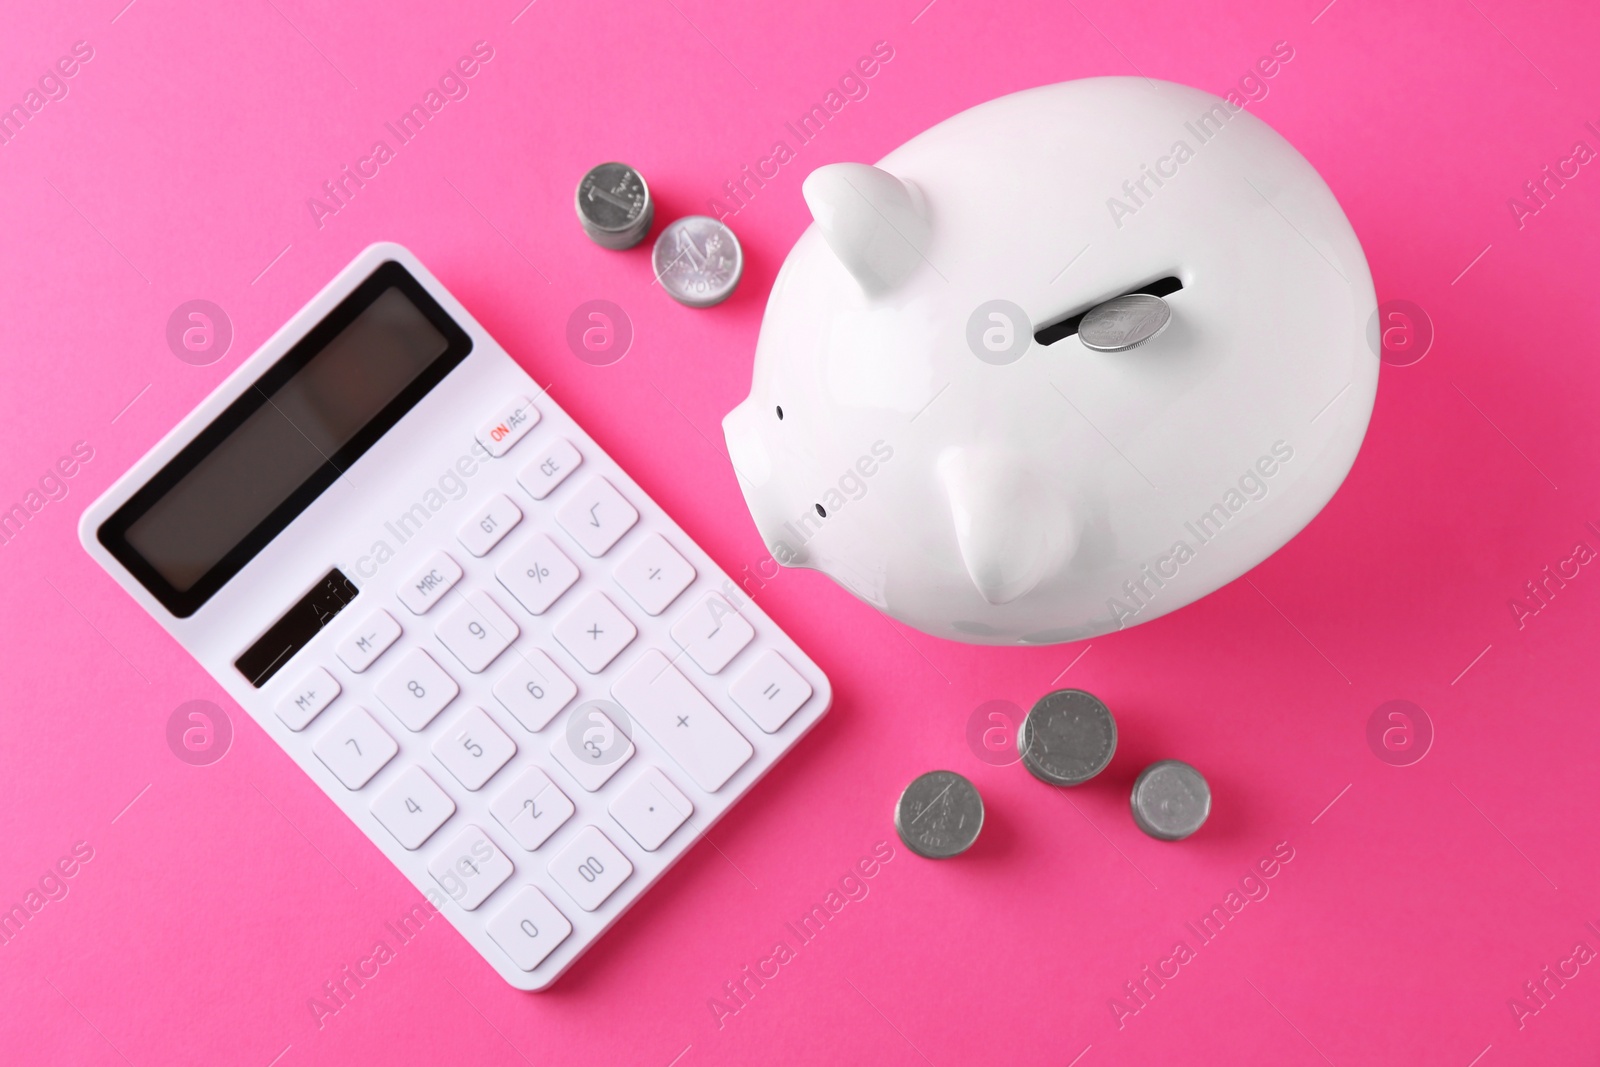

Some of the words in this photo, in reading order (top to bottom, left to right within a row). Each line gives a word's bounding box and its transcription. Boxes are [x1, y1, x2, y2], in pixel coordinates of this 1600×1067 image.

[588, 185, 632, 213] 1
[675, 224, 709, 274] 1
[490, 409, 527, 442] ON/AC
[540, 458, 559, 477] CE
[480, 514, 498, 534] GT
[416, 569, 443, 597] MRC
[468, 621, 486, 640] 9
[407, 680, 426, 699] 8
[526, 681, 545, 700] 6
[295, 690, 316, 712] M+
[345, 738, 362, 757] 7
[463, 739, 484, 758] 5
[583, 740, 602, 759] 3
[404, 797, 423, 814] 4
[523, 799, 543, 819] 2
[462, 859, 481, 875] 1
[577, 855, 604, 883] 00
[520, 918, 539, 938] 0
